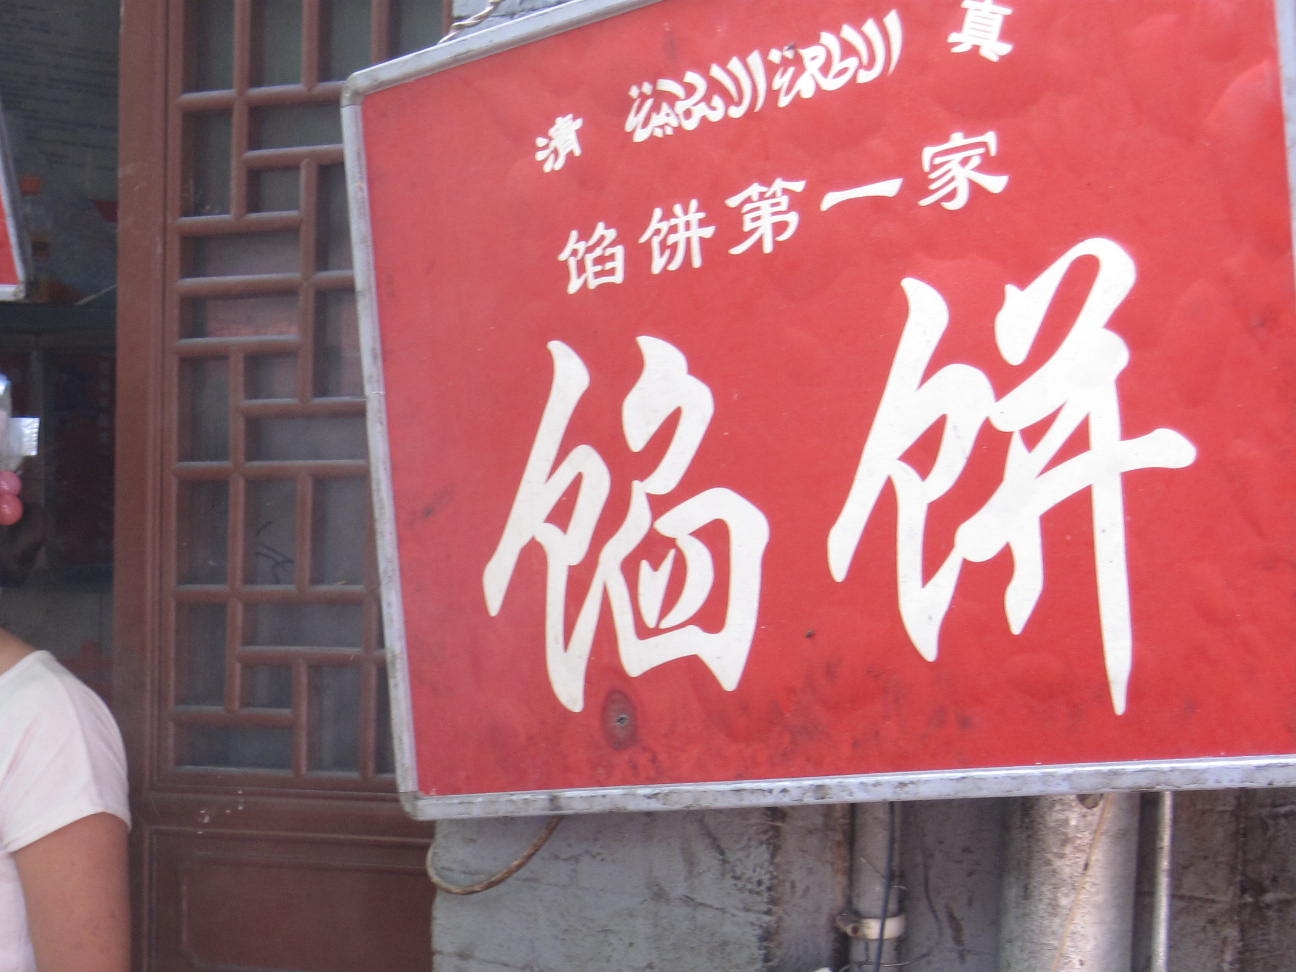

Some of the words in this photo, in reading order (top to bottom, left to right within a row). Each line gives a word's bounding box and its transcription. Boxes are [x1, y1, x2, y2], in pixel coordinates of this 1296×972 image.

[534, 113, 585, 173] 清
[946, 0, 1014, 63] 真
[557, 130, 1010, 295] 馅饼第一家
[482, 237, 1197, 716] 馅饼
